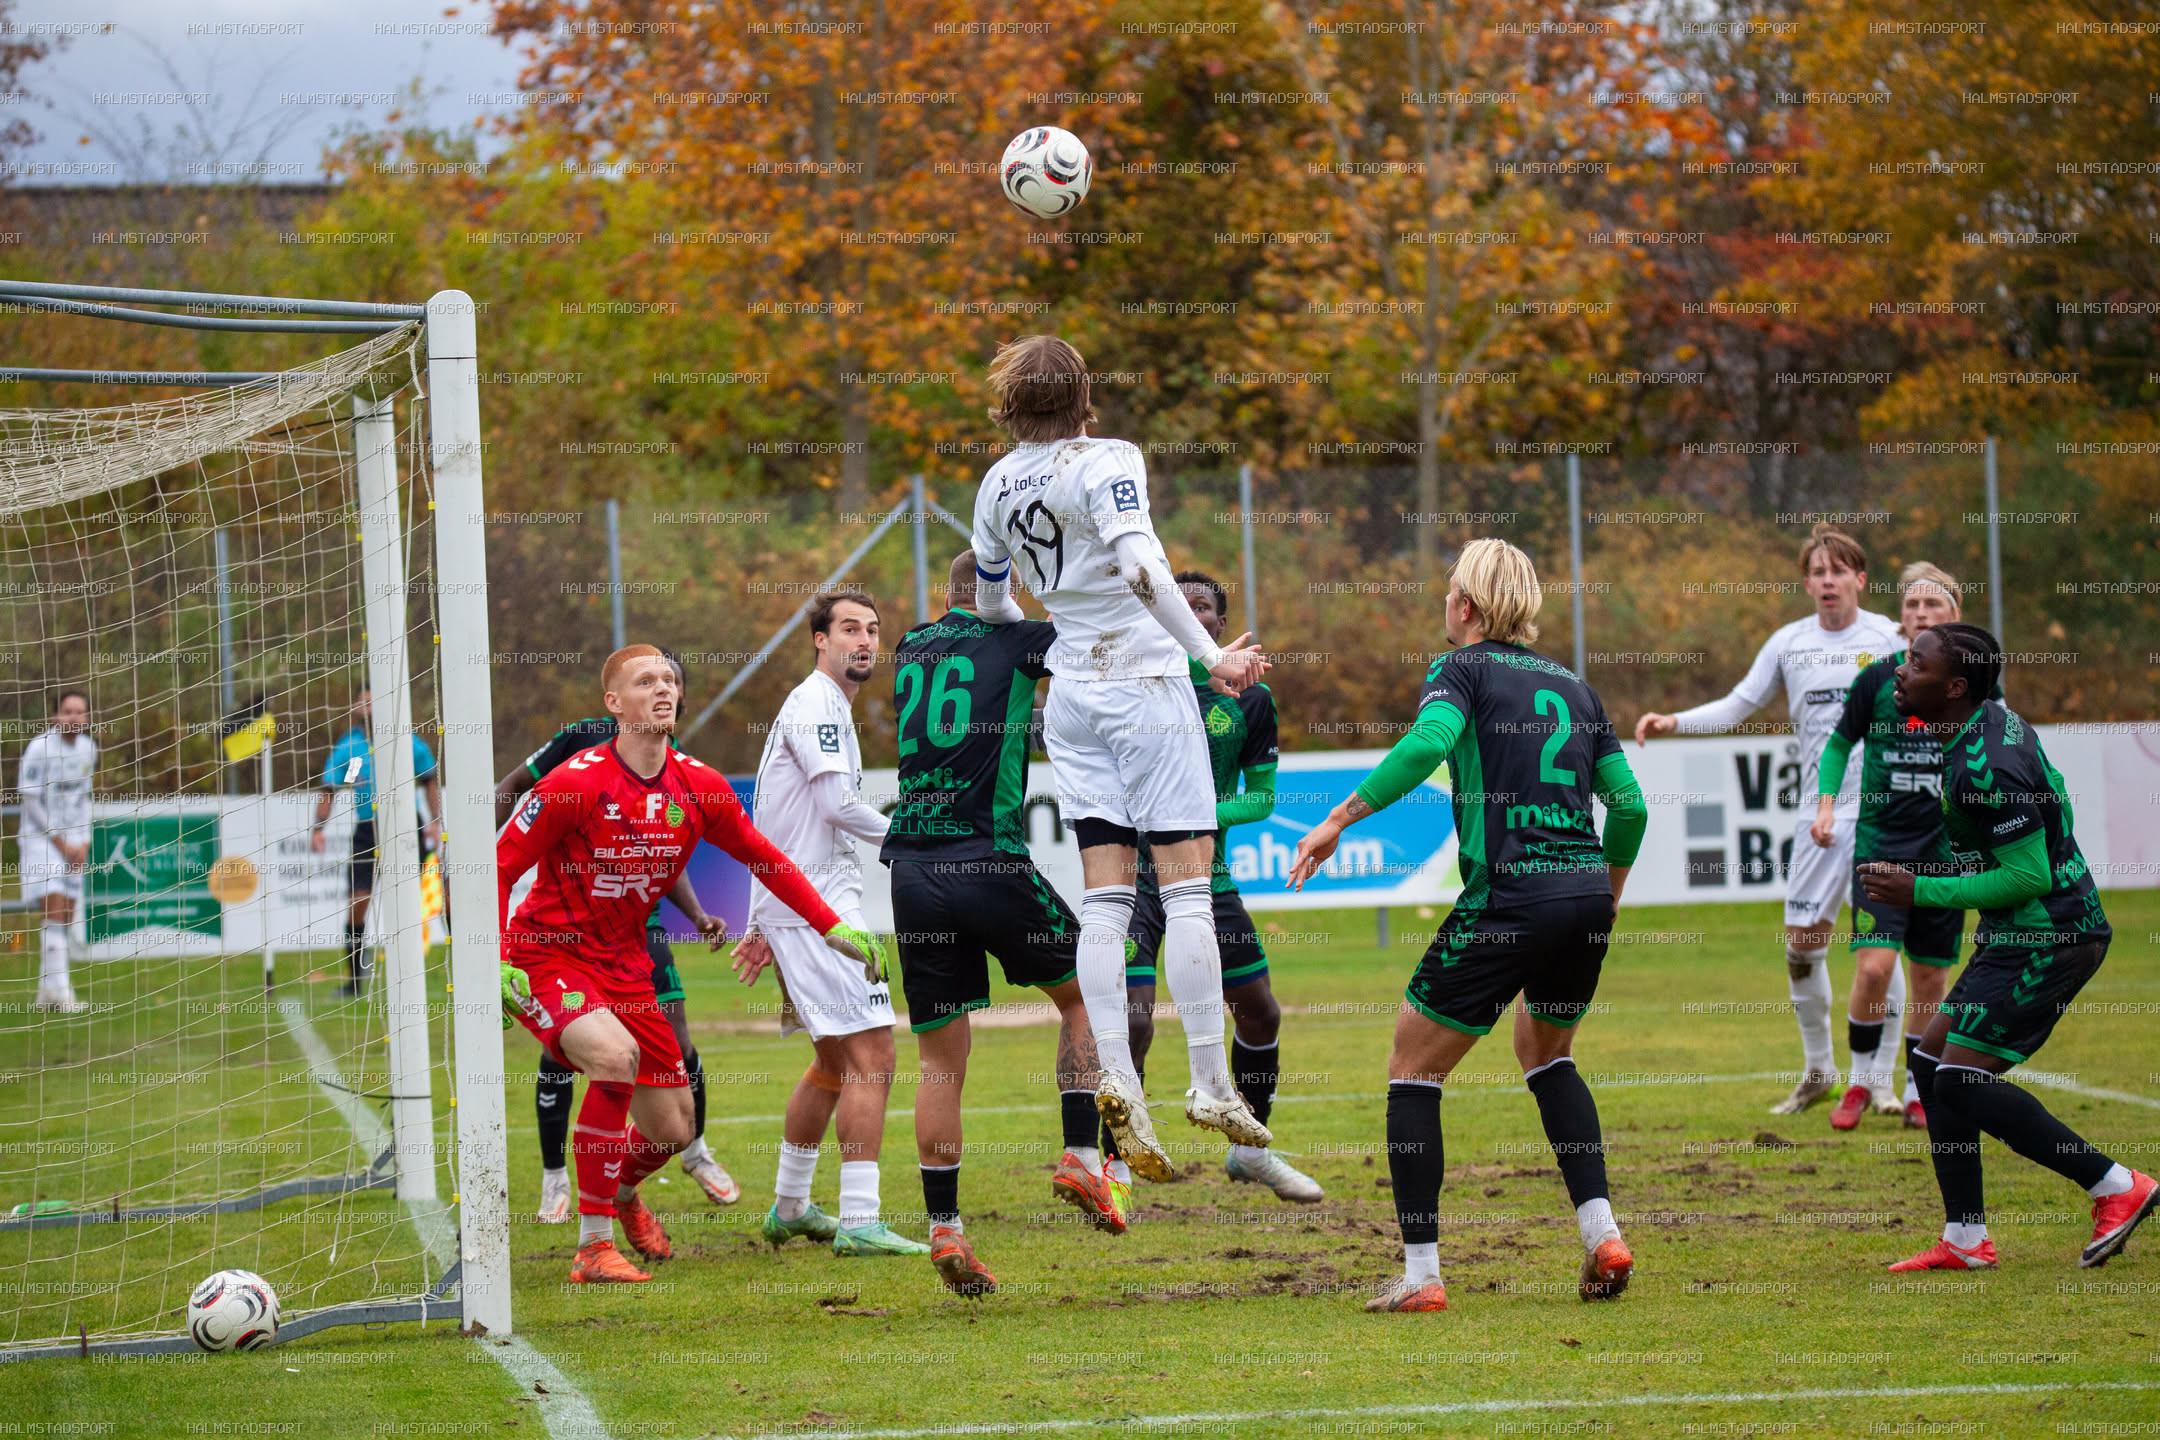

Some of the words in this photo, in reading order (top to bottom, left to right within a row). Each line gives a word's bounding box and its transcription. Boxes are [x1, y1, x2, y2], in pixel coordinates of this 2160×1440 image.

[1007, 500, 1064, 591] 19
[895, 655, 975, 759] 26
[1534, 689, 1576, 787] 2
[890, 819, 974, 836] ELLNESS
[1993, 814, 2029, 834] ADWALL
[612, 833, 675, 842] TRELLEBORG
[594, 845, 682, 860] BILCENTER
[1958, 1003, 1990, 1033] 17
